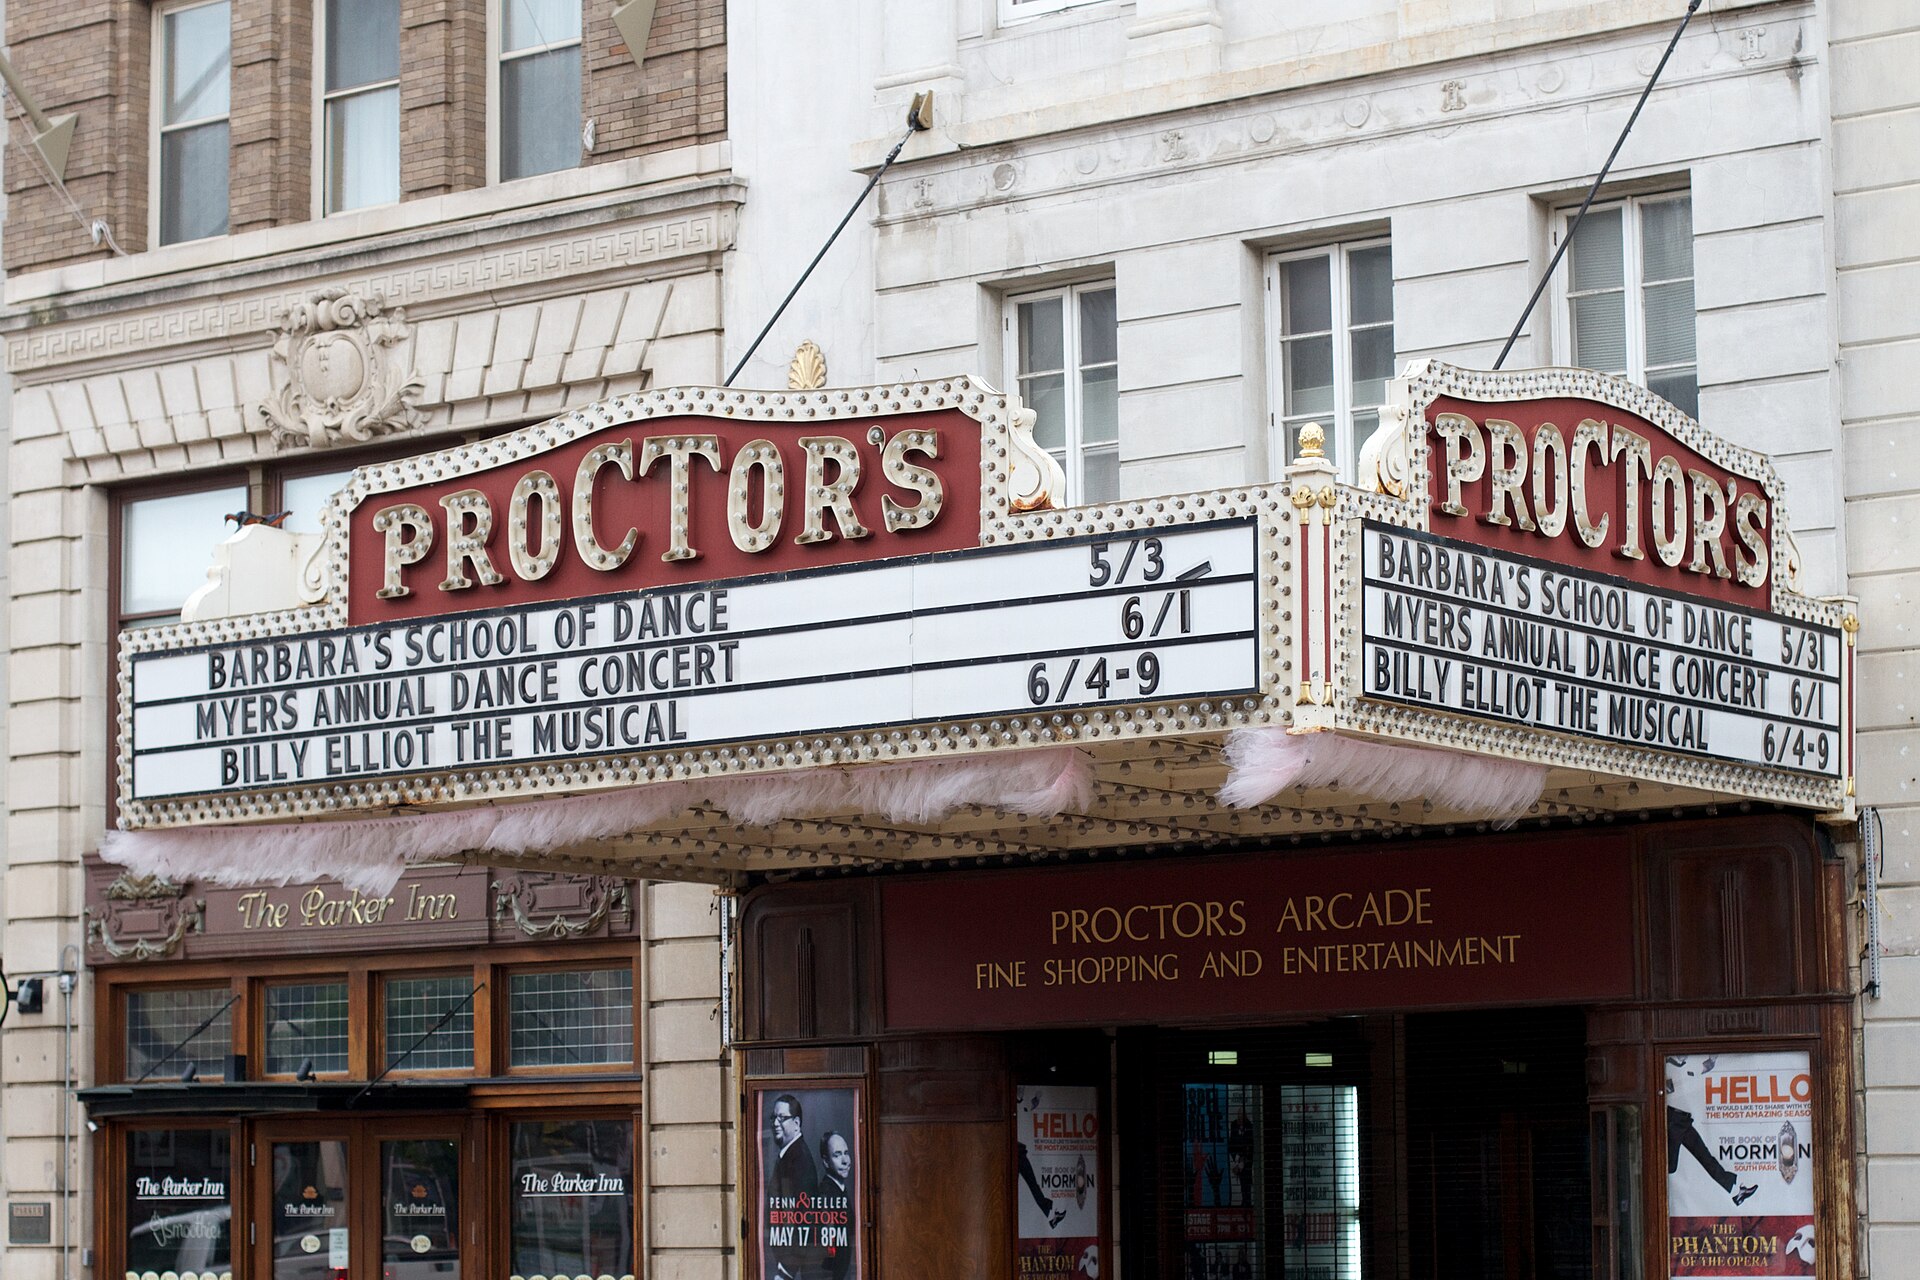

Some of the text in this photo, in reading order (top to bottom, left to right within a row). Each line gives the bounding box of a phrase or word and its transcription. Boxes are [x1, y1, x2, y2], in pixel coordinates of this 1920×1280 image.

[373, 425, 948, 600] PROCTOR'S
[1434, 412, 1769, 589] PROCTOR'S
[1379, 533, 1825, 672] BARBARA'S SCHOOL OF DANCE 5/31
[208, 629, 392, 690] BARBARA'S
[405, 613, 537, 667] SCHOOL
[554, 605, 596, 649] OF
[613, 590, 728, 642] DANCE
[196, 589, 1191, 740] MYERS ANNUAL DANCE CONCERT 6/1
[1384, 591, 1824, 720] MYERS ANNUAL DANCE CONCERT 6/1
[221, 651, 1160, 786] BILLY ELLIOT THE MUSICAL 6/4-9
[1374, 646, 1829, 770] BILLY ELLIOT THE MUSICAL 6/4-9
[237, 883, 458, 929] The Parker Inn
[1051, 888, 1433, 945] PROCTORS ARCADE
[976, 935, 1521, 989] FINE SHOPPING AND ENTERTAINMENT
[1705, 1074, 1811, 1104] HELLO
[1033, 1113, 1098, 1138] HELLO
[1738, 1136, 1762, 1144] BOOK
[136, 1175, 225, 1195] The Parker Inn
[522, 1171, 624, 1192] The Parker Inn
[284, 1204, 298, 1214] The
[394, 1203, 407, 1214] The
[769, 1197, 796, 1209] PENN
[811, 1197, 848, 1209] TELLER
[780, 1211, 848, 1224] PROCTORS
[1711, 1223, 1737, 1235] THE
[769, 1226, 848, 1247] MAY 17 8PM
[1672, 1236, 1777, 1255] PHANTOM
[1681, 1256, 1769, 1267] OF THE OPERA
